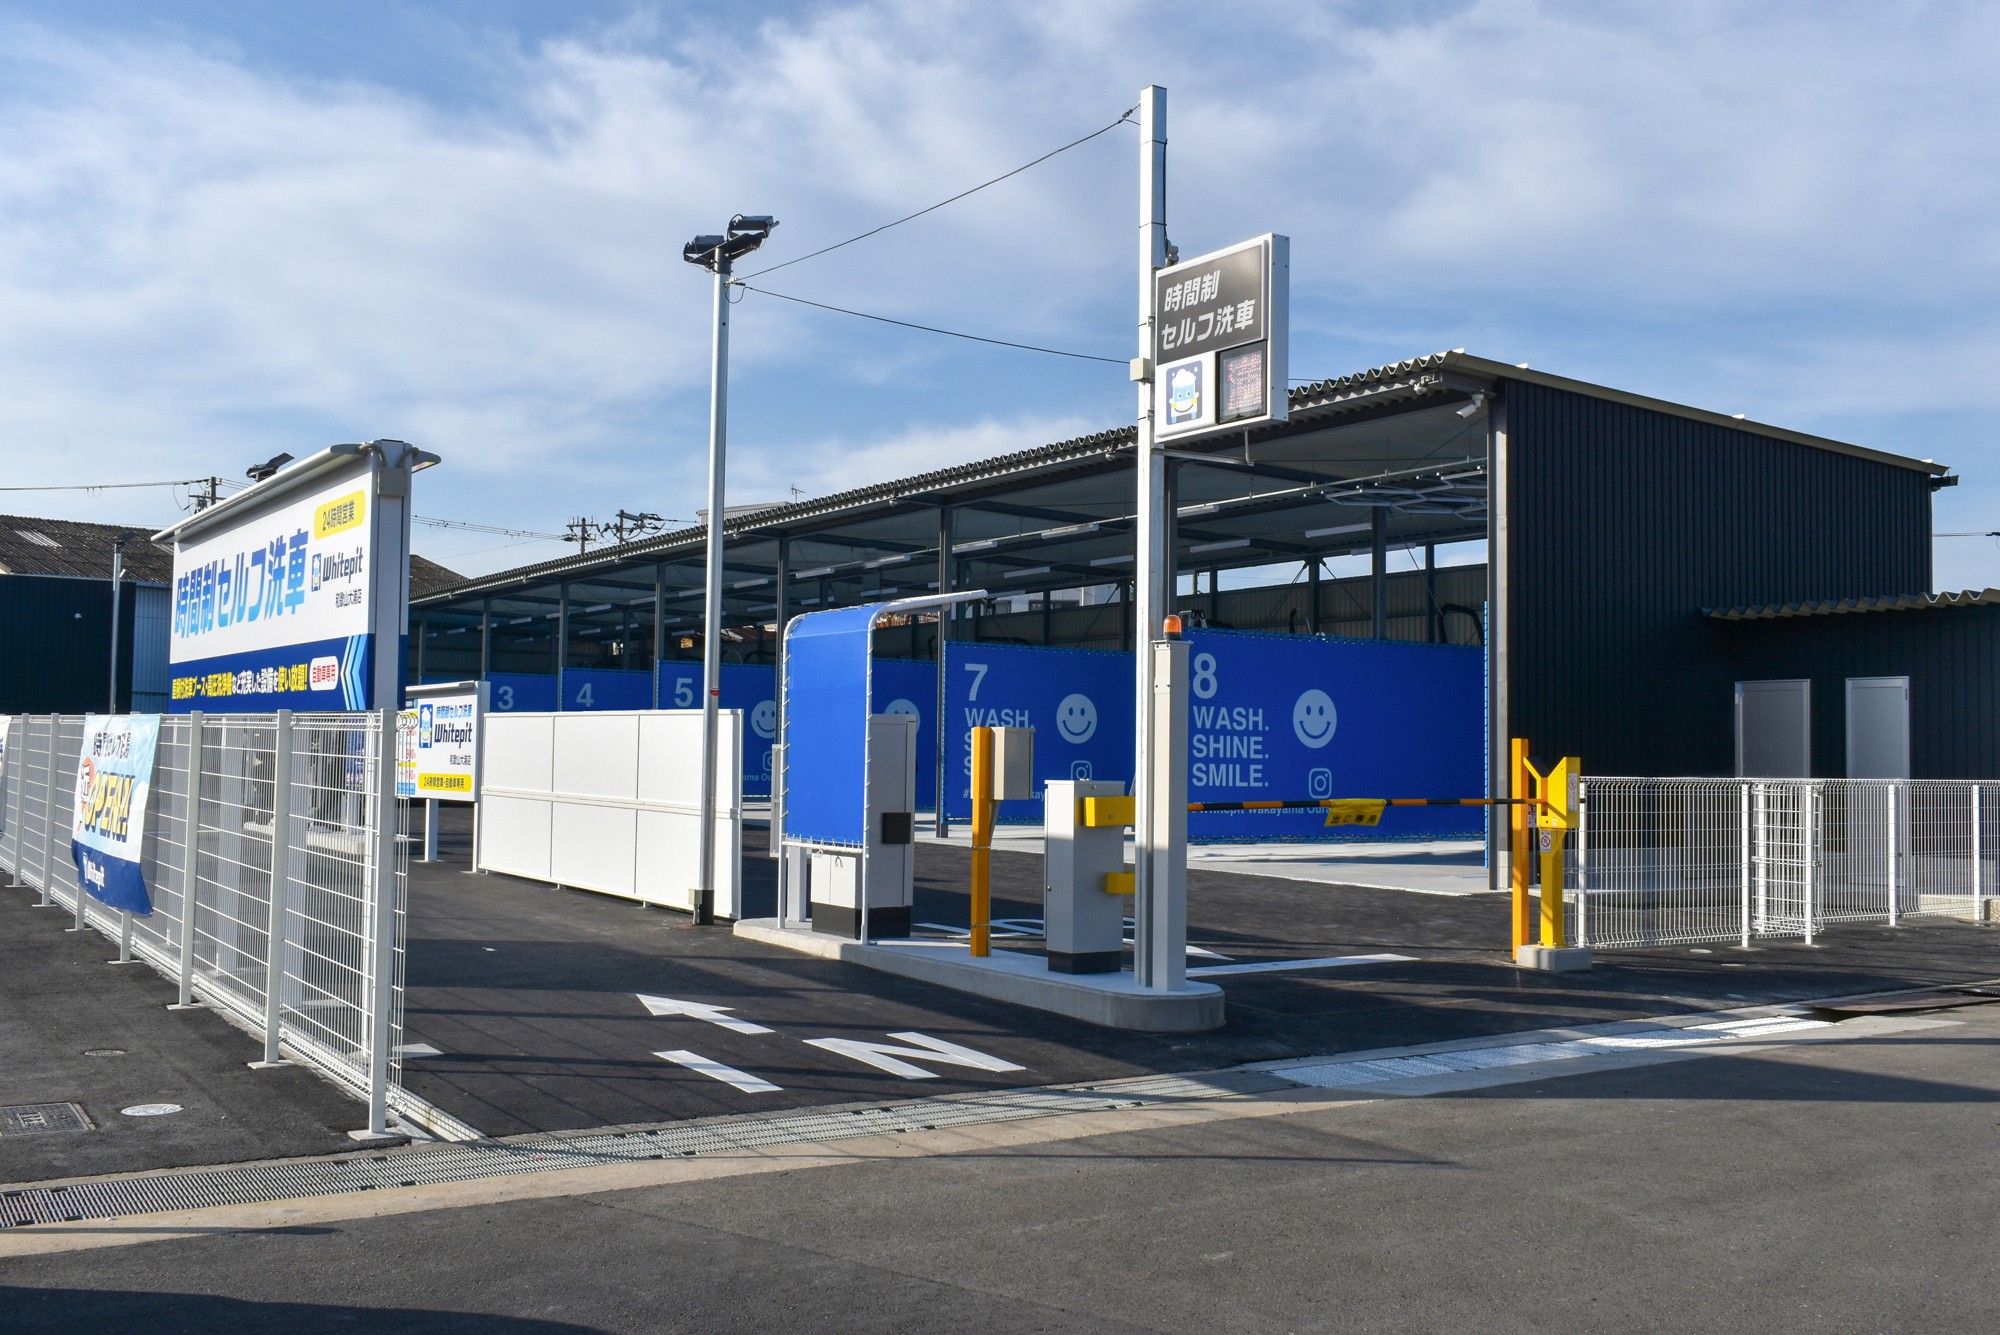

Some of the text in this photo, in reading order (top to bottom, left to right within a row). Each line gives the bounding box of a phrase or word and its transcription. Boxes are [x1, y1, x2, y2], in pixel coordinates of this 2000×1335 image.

[1163, 269, 1221, 313] 時間制
[1161, 299, 1256, 351] セルフ洗車
[322, 499, 355, 532] 24時間営業
[322, 546, 364, 584] Whitepit
[174, 527, 309, 639] 時間制セルフ洗車
[964, 663, 988, 701] 7
[1192, 652, 1218, 699] 8
[497, 685, 514, 710] 3
[576, 682, 594, 707] 4
[674, 677, 693, 707] 5
[435, 704, 473, 719] 時間制セルフ洗車
[964, 707, 1035, 728] WASH.
[1192, 705, 1270, 732] WASH.
[433, 722, 473, 749] Whitepit
[1192, 734, 1270, 760] SHINE.
[1192, 763, 1269, 787] SMILE.
[653, 1031, 1027, 1094] IN
